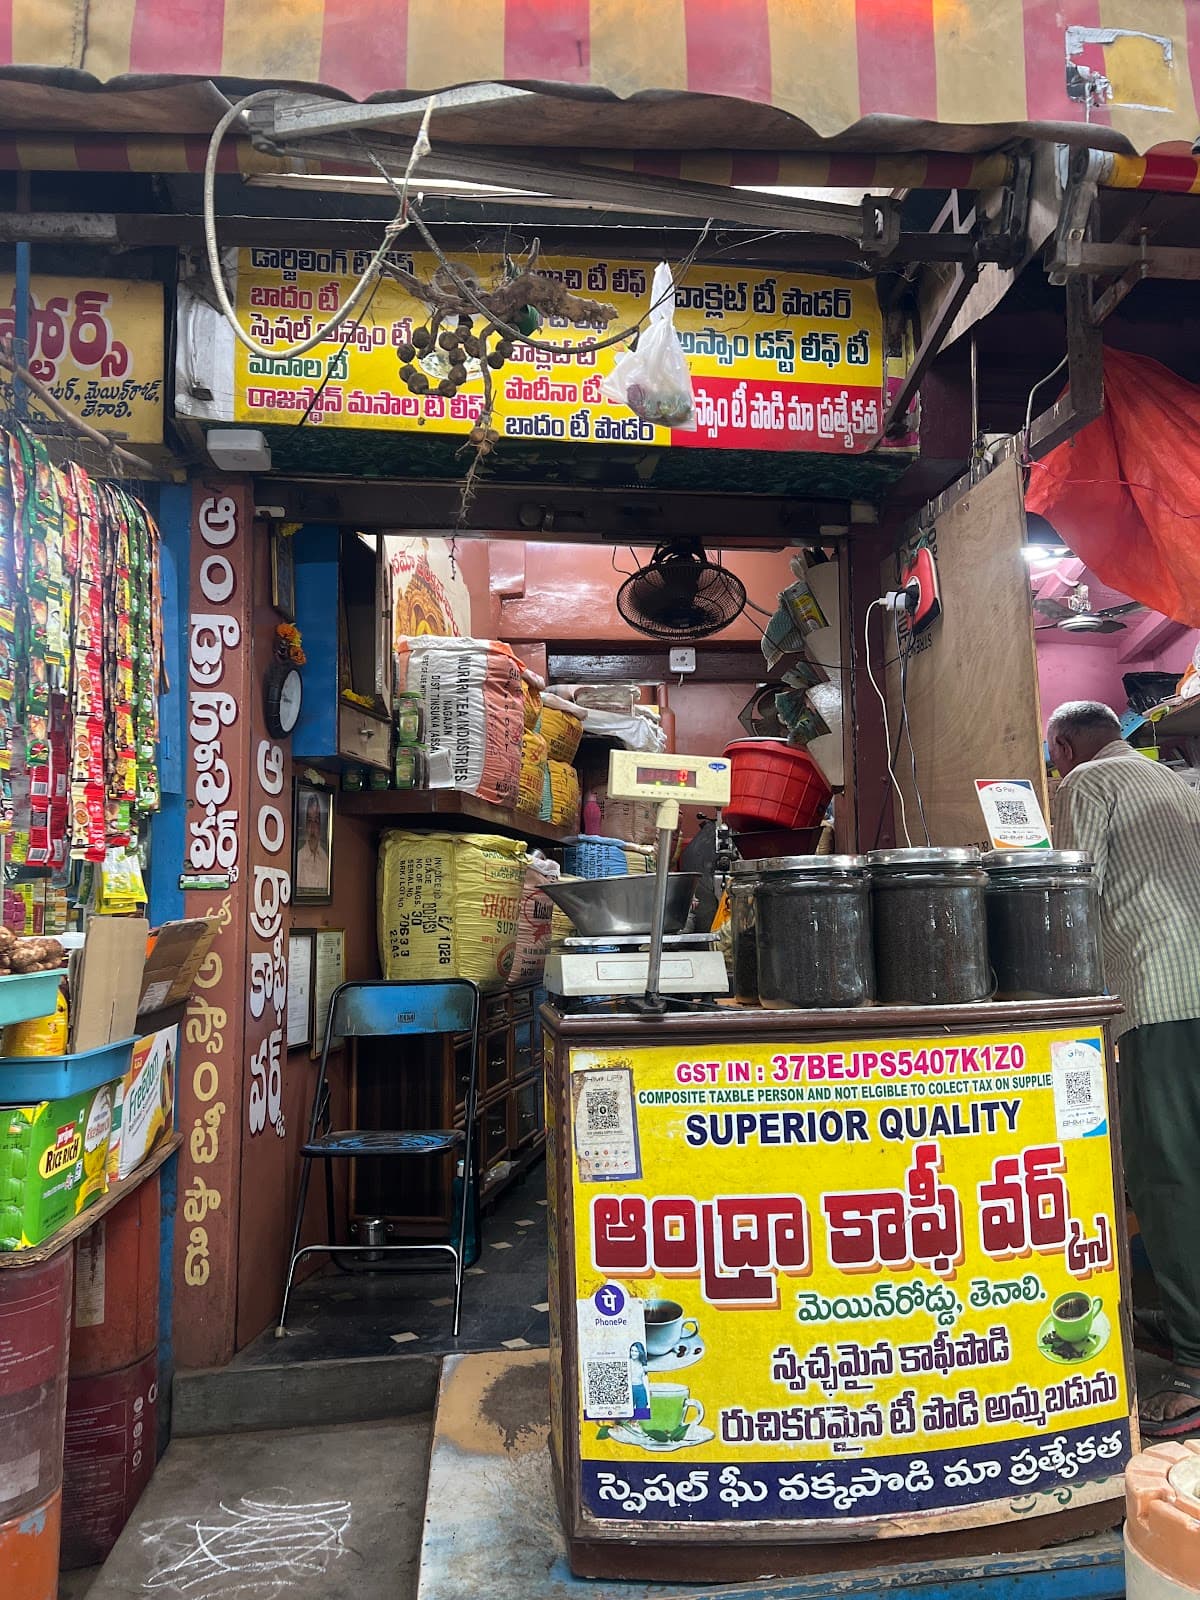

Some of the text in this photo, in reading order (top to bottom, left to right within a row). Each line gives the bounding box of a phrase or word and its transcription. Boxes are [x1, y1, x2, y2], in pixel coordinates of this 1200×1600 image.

[251, 280, 340, 312] బాదం టీ
[588, 262, 608, 291] టీ
[612, 268, 646, 297] లీఫ్
[753, 278, 777, 314] టీ
[250, 313, 313, 346] స్పెషల్
[755, 330, 795, 374] డస్ట్
[801, 332, 840, 368] లీఫ్
[846, 330, 871, 365] టీ
[80, 399, 133, 418] తెనాలి.
[347, 391, 420, 417] మసాల
[693, 388, 729, 439] స్సాం
[731, 381, 748, 429] టీ
[787, 395, 814, 432] మా
[817, 390, 879, 449] ప్రత్యేకత
[505, 414, 565, 437] బాదం
[570, 409, 590, 439] టీ
[456, 696, 470, 717] TEA
[428, 730, 441, 754] (ASSA
[455, 720, 470, 783] INDUSTRIES
[676, 1062, 720, 1084] GST
[728, 1061, 750, 1082] IN
[772, 1044, 1025, 1082] 37BEJPS5407K1Z0
[638, 1074, 1053, 1104] COMPOSITE TAXBLE PERSON AND NOT ELGIBLE TO COLECT TAX ON SUPPLIE
[189, 1101, 226, 1165] టీ
[686, 1100, 1021, 1146] SUPERIOR QUALITY
[45, 1138, 79, 1174] RICE RICH
[594, 1196, 806, 1301] ఆంధ్రా
[825, 1144, 958, 1272] కాఫీ
[969, 1275, 1047, 1307] తెనాలి.
[594, 1317, 628, 1327] PhonePe
[890, 1390, 916, 1434] టీ
[922, 1389, 979, 1431] పొడి
[597, 1470, 710, 1514] స్పెషల్
[943, 1458, 1002, 1488] మా
[1008, 1429, 1123, 1486] ప్రత్యేకత
